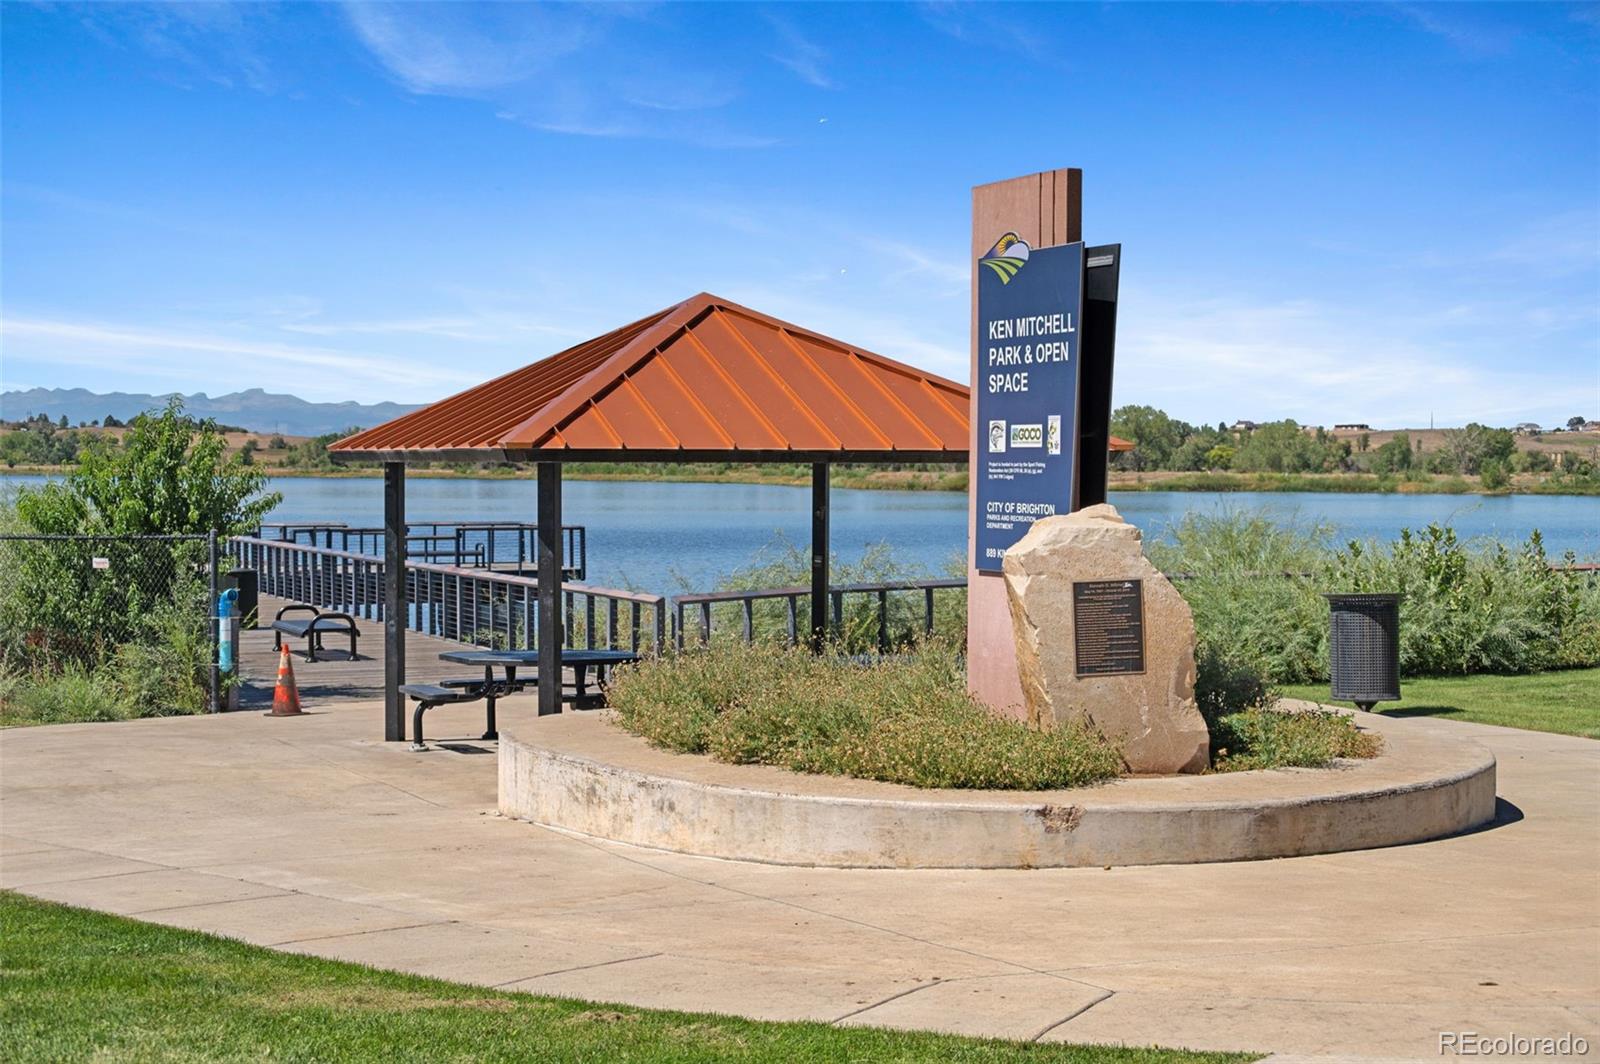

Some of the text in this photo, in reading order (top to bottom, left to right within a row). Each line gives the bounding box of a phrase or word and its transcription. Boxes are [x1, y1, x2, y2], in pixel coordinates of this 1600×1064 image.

[989, 313, 1075, 340] KEN MITCHELL
[989, 342, 1069, 366] PARK & OPEN
[988, 372, 1029, 393] SPACE
[1018, 427, 1042, 441] GOCO
[986, 501, 1056, 515] CITY OF BRIGHTON
[986, 522, 1014, 530] DEPARTMENT
